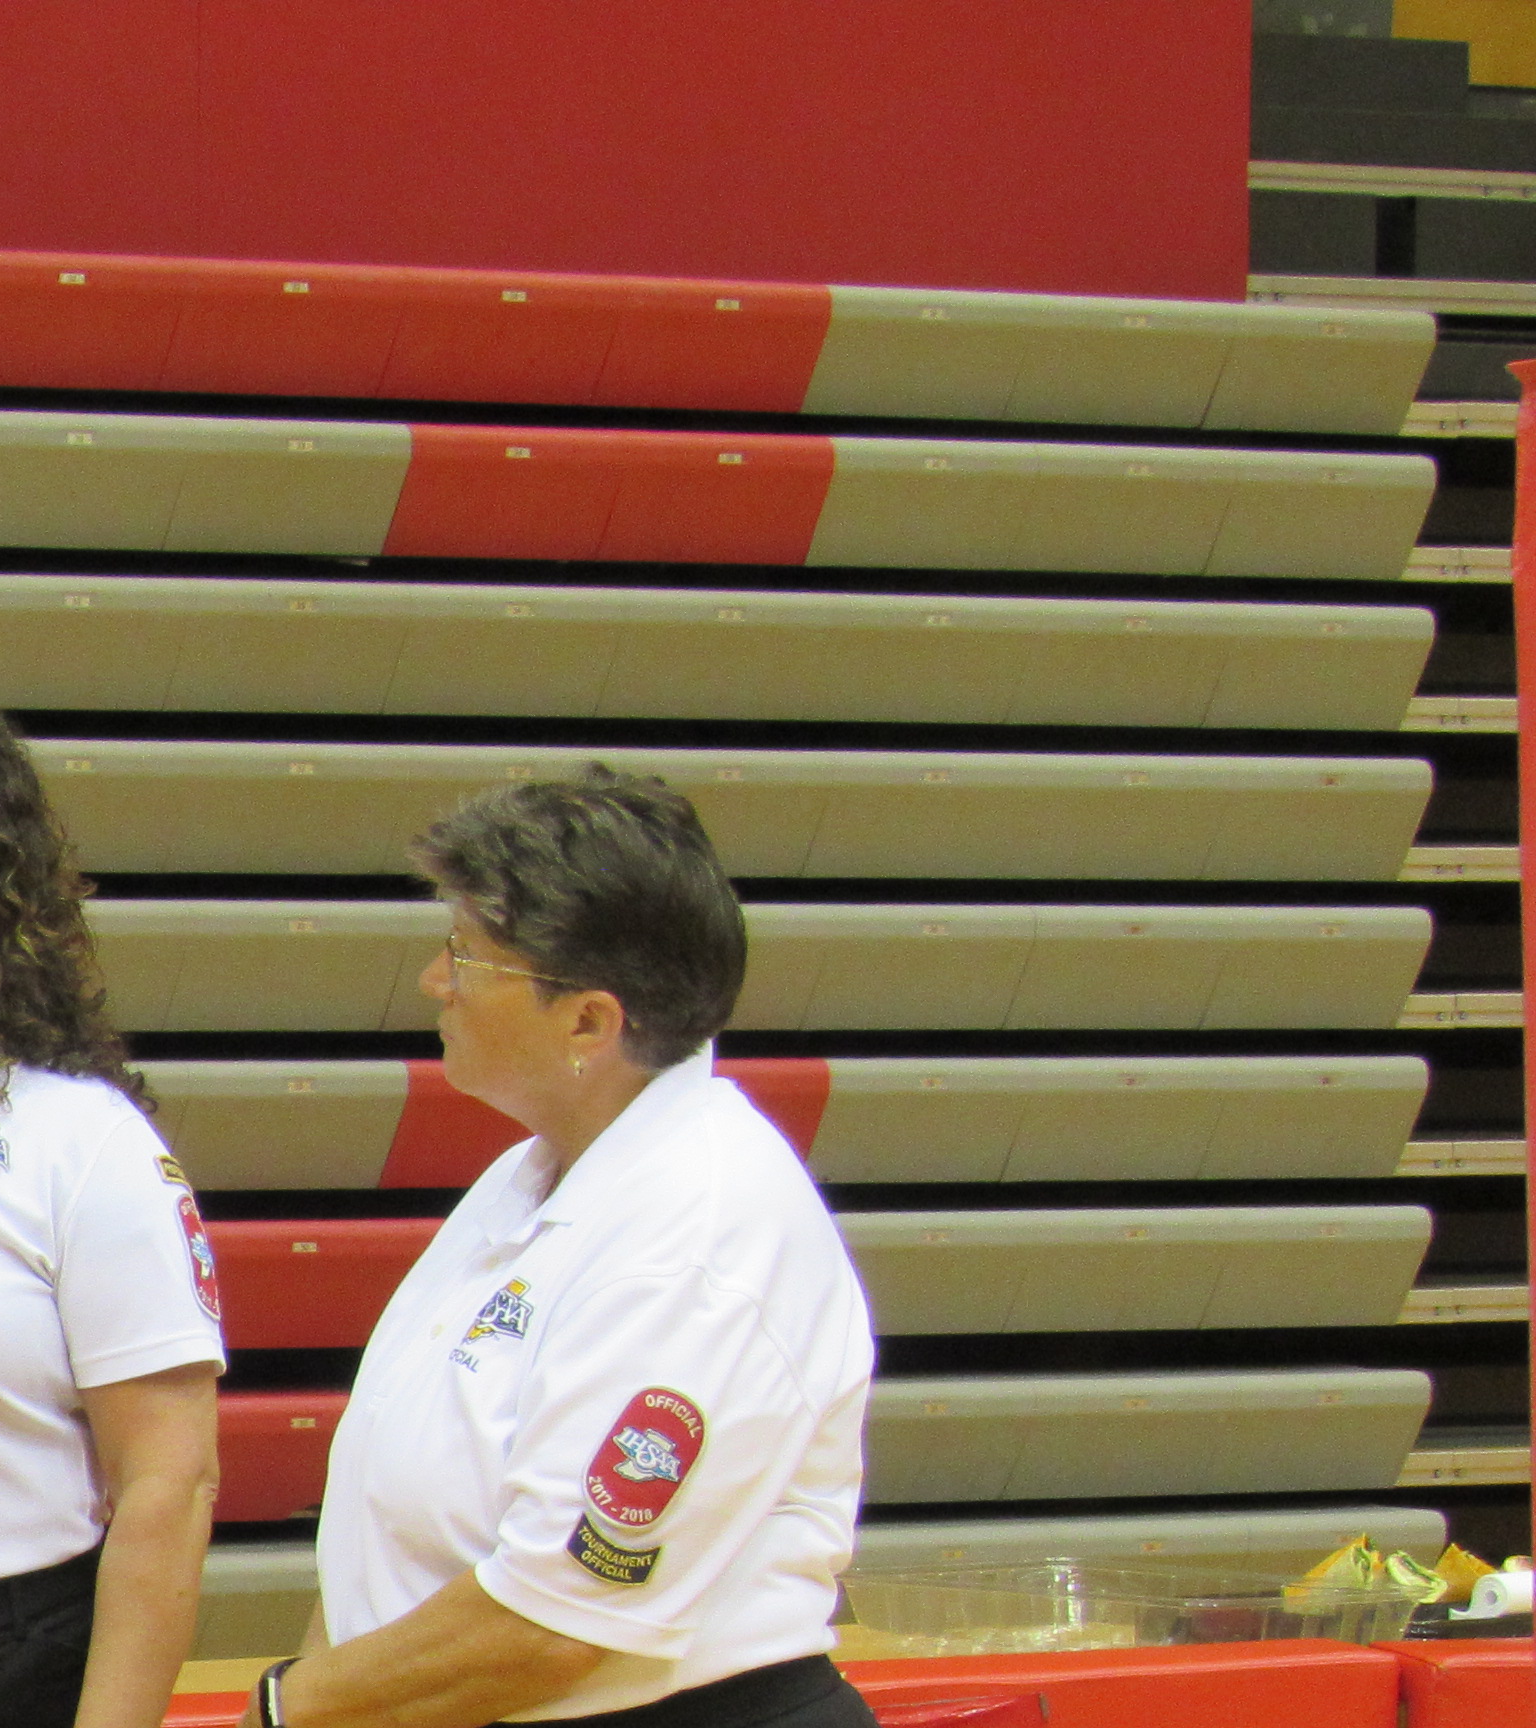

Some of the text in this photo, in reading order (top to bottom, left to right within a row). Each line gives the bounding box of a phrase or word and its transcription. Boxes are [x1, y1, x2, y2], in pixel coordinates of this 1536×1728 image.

[644, 1394, 704, 1438] OFFICIAL
[617, 1428, 680, 1479] IHSAA
[588, 1475, 613, 1507] 2017
[619, 1506, 653, 1522] 2018
[578, 1526, 653, 1567] TOURNAMENT
[581, 1550, 632, 1579] OFFICIAL
